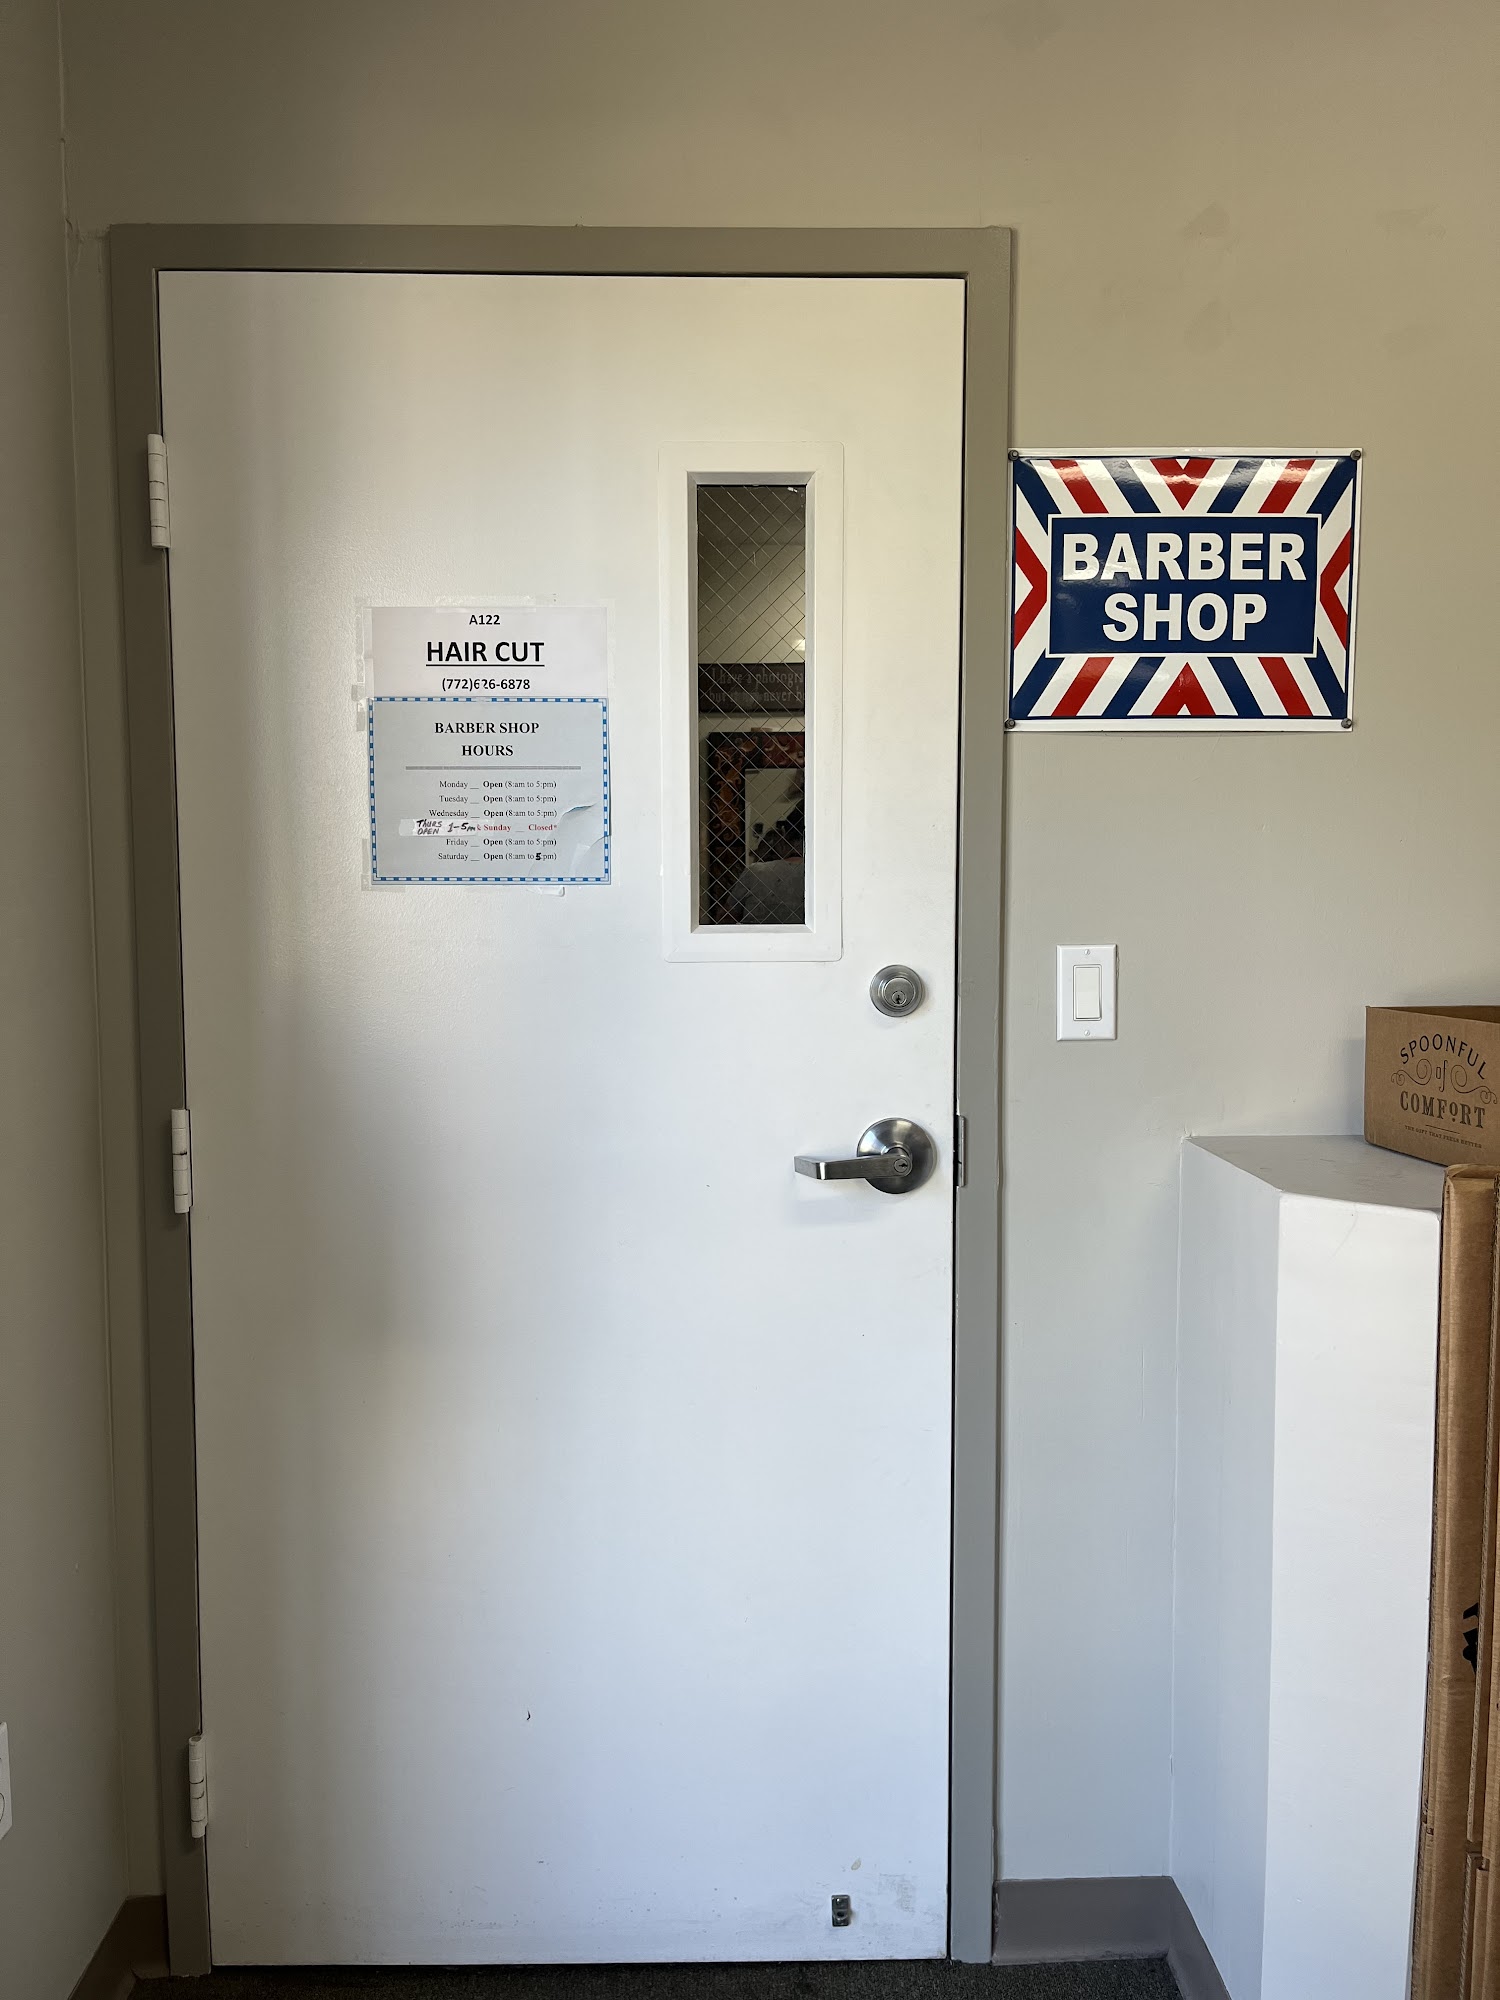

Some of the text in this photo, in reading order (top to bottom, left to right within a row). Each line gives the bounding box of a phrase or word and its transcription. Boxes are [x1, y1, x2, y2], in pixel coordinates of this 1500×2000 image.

[1062, 533, 1306, 581] BARBER
[469, 614, 501, 625] A122
[1102, 593, 1267, 642] SHOP
[427, 641, 545, 662] HAIR CUT
[442, 678, 531, 692] (772)626-6878
[434, 722, 539, 734] BARBER SHOP
[461, 744, 514, 756] HOURS
[439, 781, 468, 789] Monday
[483, 781, 503, 789] Open
[505, 781, 525, 789] (8:am
[536, 781, 557, 789] 5:pm)
[439, 795, 468, 803] Tuesday
[483, 795, 503, 803] Open
[505, 795, 525, 803] (8:am
[536, 795, 557, 803] 5:pm)
[429, 810, 469, 818] Wednesday
[484, 810, 504, 818] Open
[506, 810, 526, 818] (8:am
[483, 824, 511, 832] Sunday
[446, 839, 468, 847] Friday
[483, 839, 503, 847] Open
[505, 839, 525, 847] (8:am
[438, 853, 468, 861] Saturday
[483, 853, 503, 861] Open
[505, 853, 525, 861] (8:am
[1400, 1033, 1487, 1080] SPOONFUL
[1435, 1059, 1448, 1092] of
[1400, 1090, 1486, 1129] COMFORT
